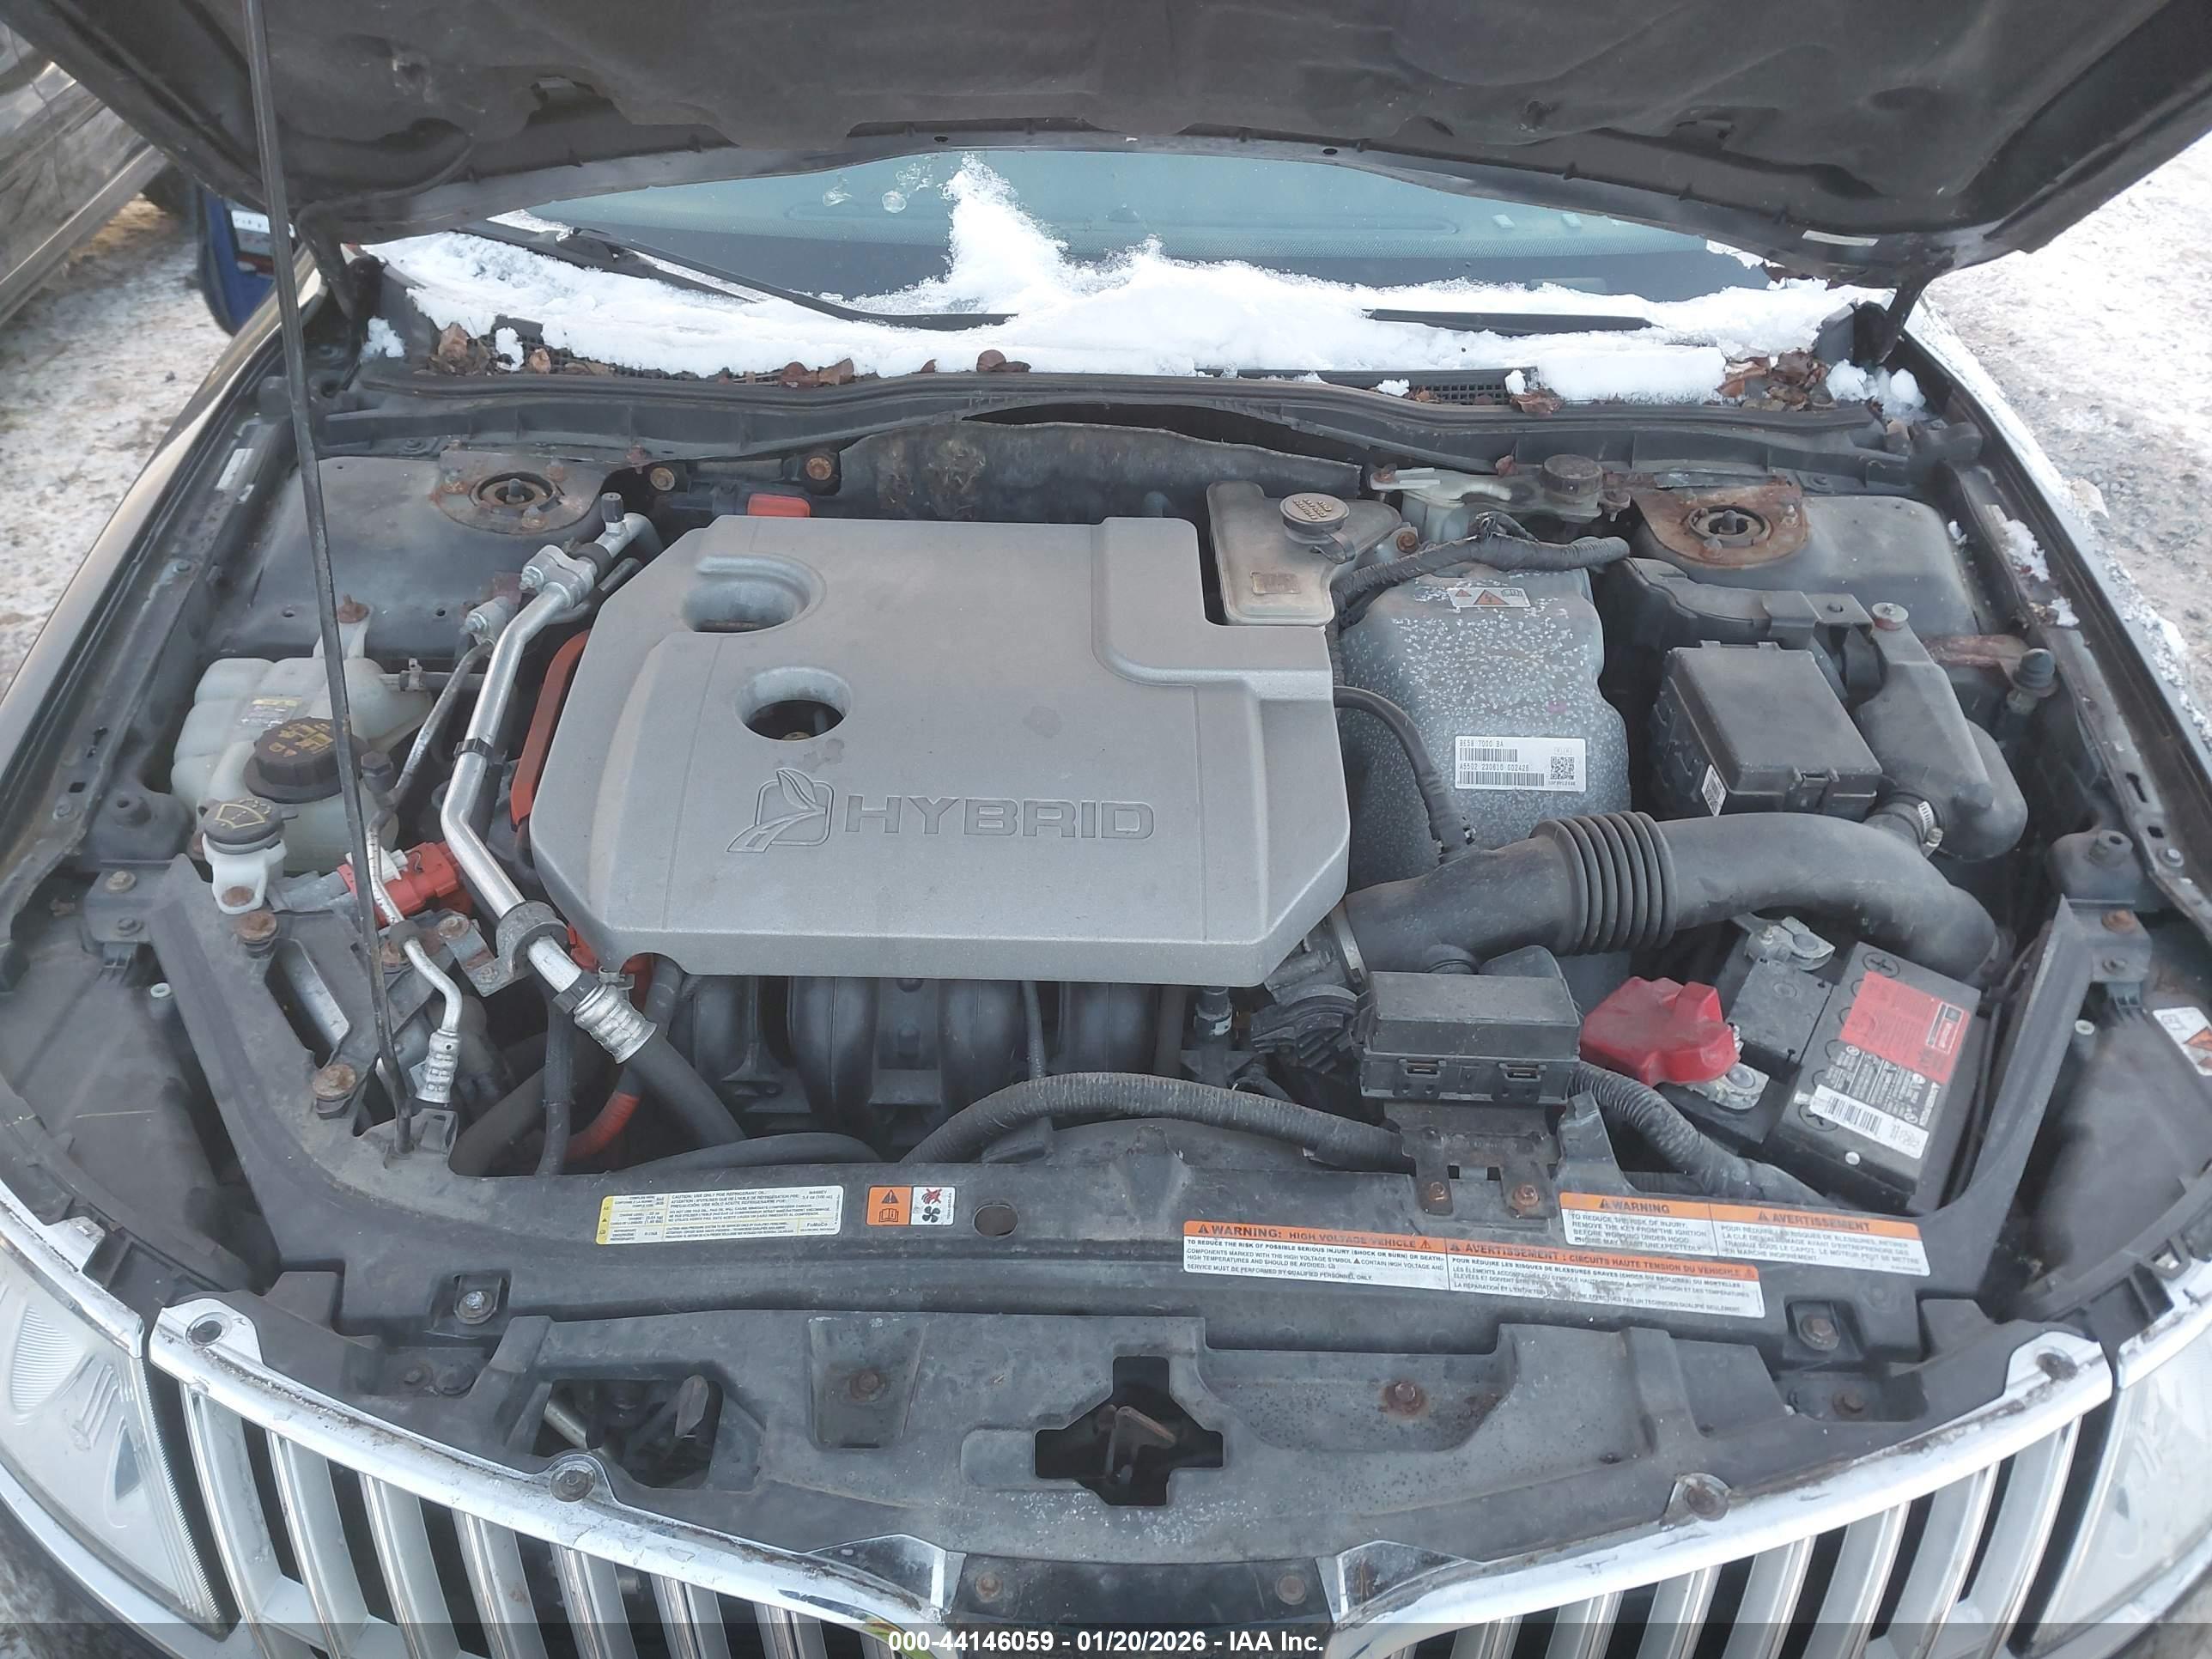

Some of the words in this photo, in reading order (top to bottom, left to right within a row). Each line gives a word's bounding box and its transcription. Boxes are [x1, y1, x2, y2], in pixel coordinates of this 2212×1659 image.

[844, 793, 1154, 840] HYBRID
[1613, 1200, 1670, 1213] WARNING
[1571, 1220, 1601, 1229] REMOVE
[1211, 1224, 1281, 1238] WARNING:
[1289, 1231, 1316, 1240] HIGH
[1319, 1234, 1366, 1244] VOLTAGE
[1572, 1228, 1601, 1237] BEFORE
[1640, 1233, 1667, 1242] UNDER
[1186, 1247, 1227, 1255] COMPONENTS
[1202, 1255, 1249, 1264] TEMPERATURES
[1465, 1243, 1559, 1260] AVERTISSEMENT
[1569, 1255, 1609, 1265] CIRCUITS
[1612, 1259, 1640, 1268] HAUTE
[1644, 1261, 1680, 1272] TENSION
[1240, 1267, 1277, 1275] PERFORMED
[1286, 1269, 1318, 1278] QUALIFIED
[1514, 1262, 1542, 1271] RISQUES
